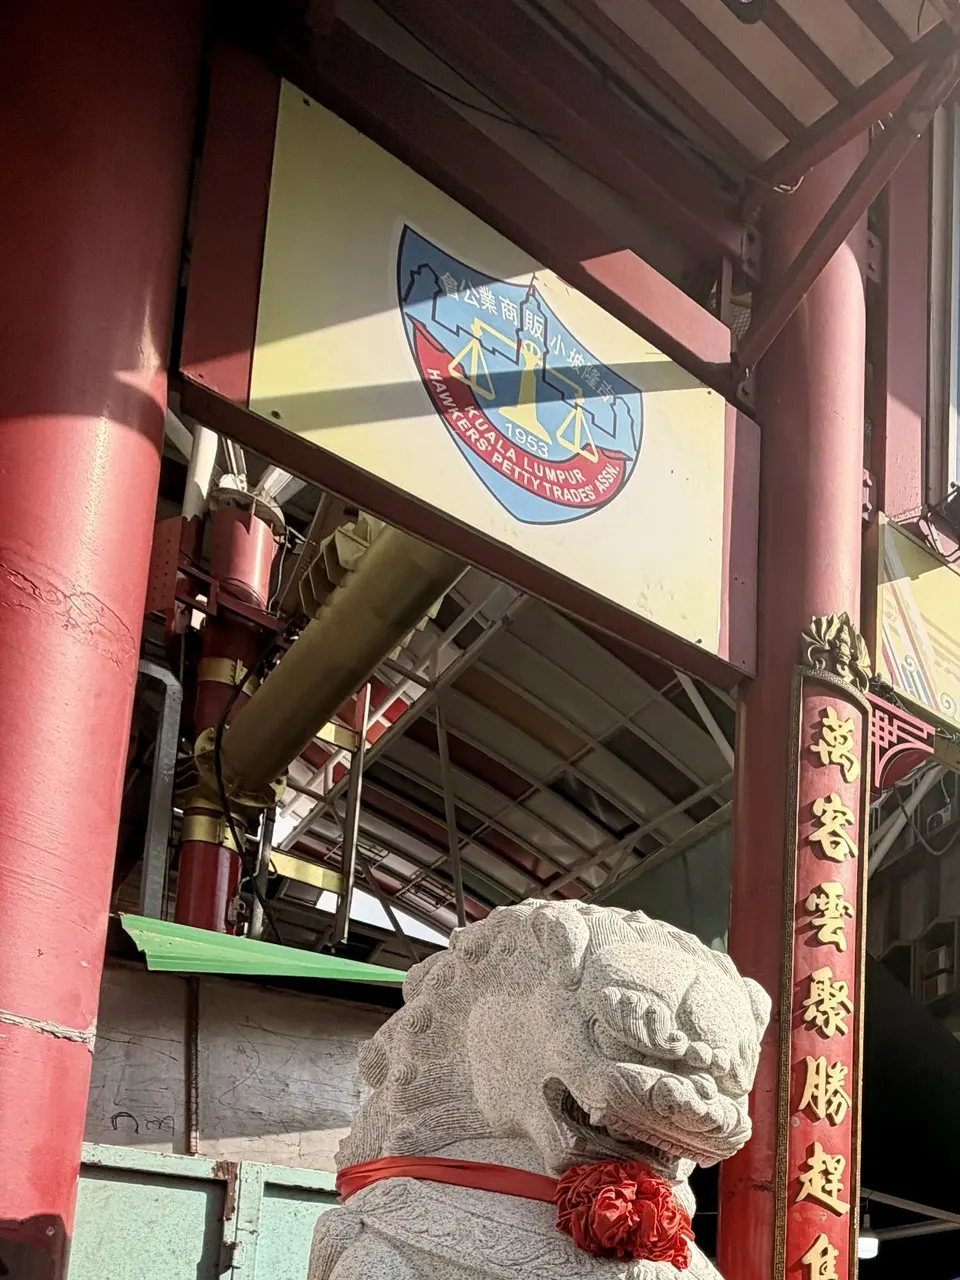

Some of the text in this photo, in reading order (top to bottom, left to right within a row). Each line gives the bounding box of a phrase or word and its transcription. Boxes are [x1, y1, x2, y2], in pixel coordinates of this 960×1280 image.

[426, 367, 492, 456] HAWKERS'
[491, 453, 541, 490] PETTY
[598, 463, 621, 494] ASSN.
[465, 405, 586, 485] KUALA LUMPUR
[504, 422, 550, 458] 1953
